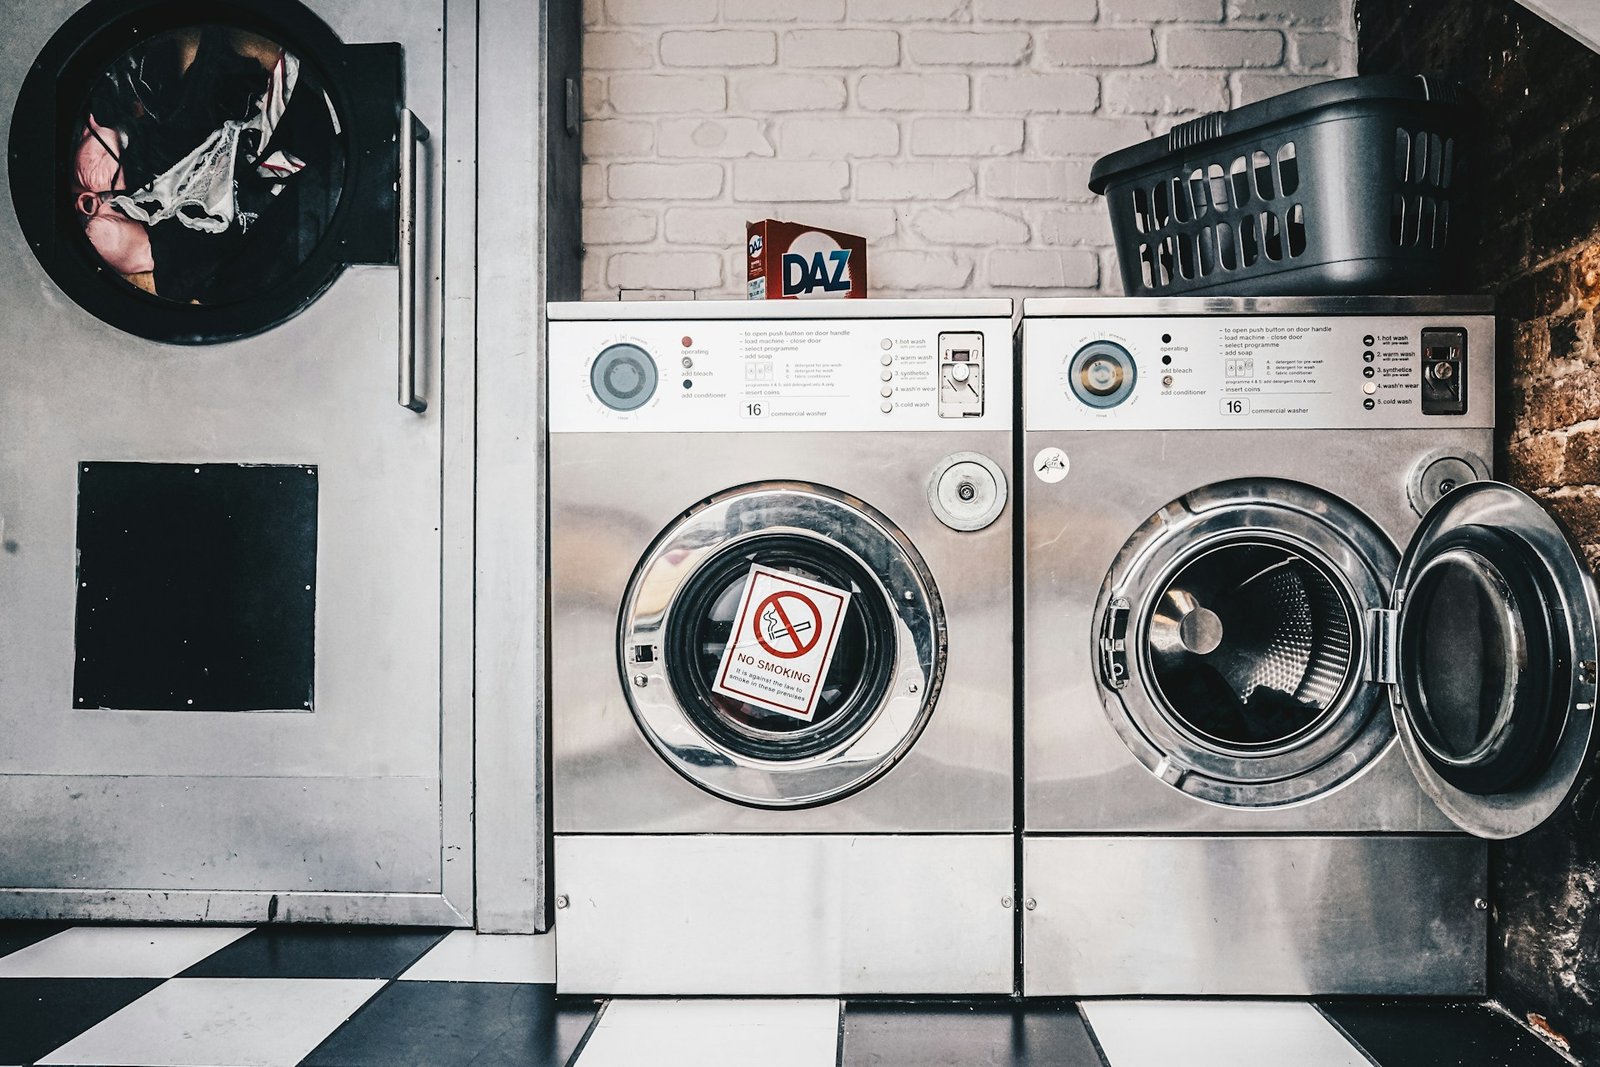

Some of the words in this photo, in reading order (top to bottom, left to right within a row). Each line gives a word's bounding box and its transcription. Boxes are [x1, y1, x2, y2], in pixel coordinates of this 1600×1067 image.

[749, 236, 762, 255] DAZ
[782, 249, 852, 296] DAZ
[747, 404, 761, 416] 16
[1227, 401, 1242, 413] 16
[738, 653, 755, 665] NO
[757, 659, 810, 683] SMOKING
[730, 675, 750, 684] smoke
[759, 683, 775, 692] these
[777, 688, 805, 702] premises
[749, 672, 772, 684] against
[773, 679, 783, 687] the
[784, 682, 794, 691] law
